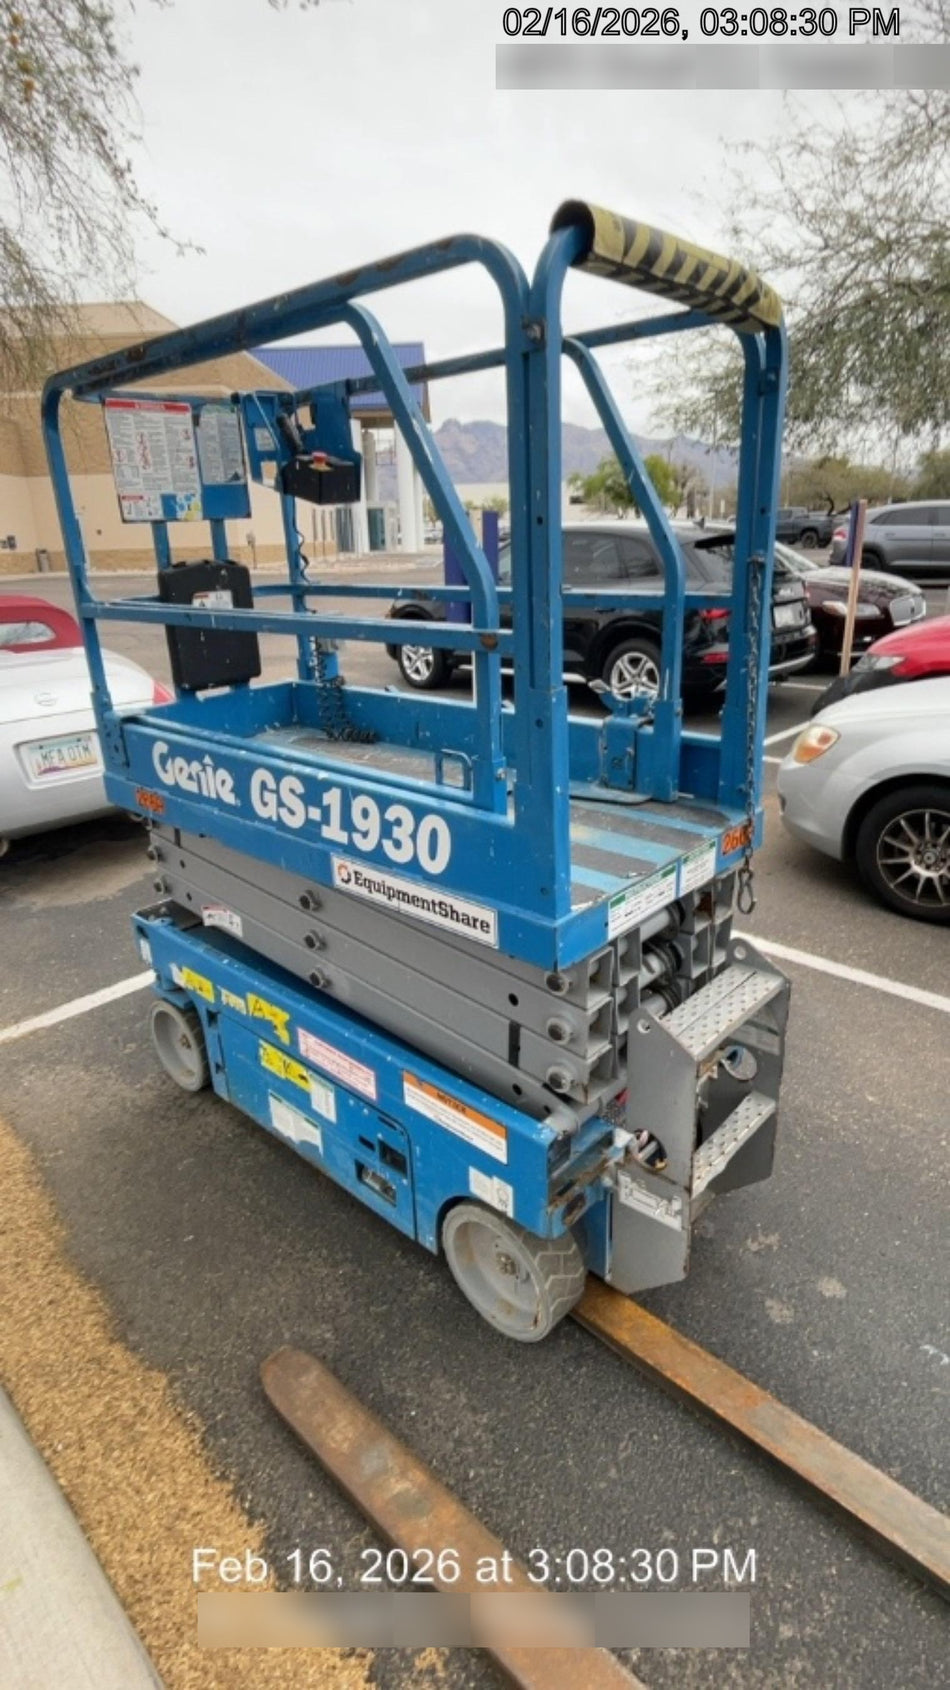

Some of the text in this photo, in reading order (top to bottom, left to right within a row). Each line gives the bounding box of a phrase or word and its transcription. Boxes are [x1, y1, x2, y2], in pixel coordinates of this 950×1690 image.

[152, 741, 452, 875] Genie GS-1930
[353, 870, 490, 934] EquipmentShare
